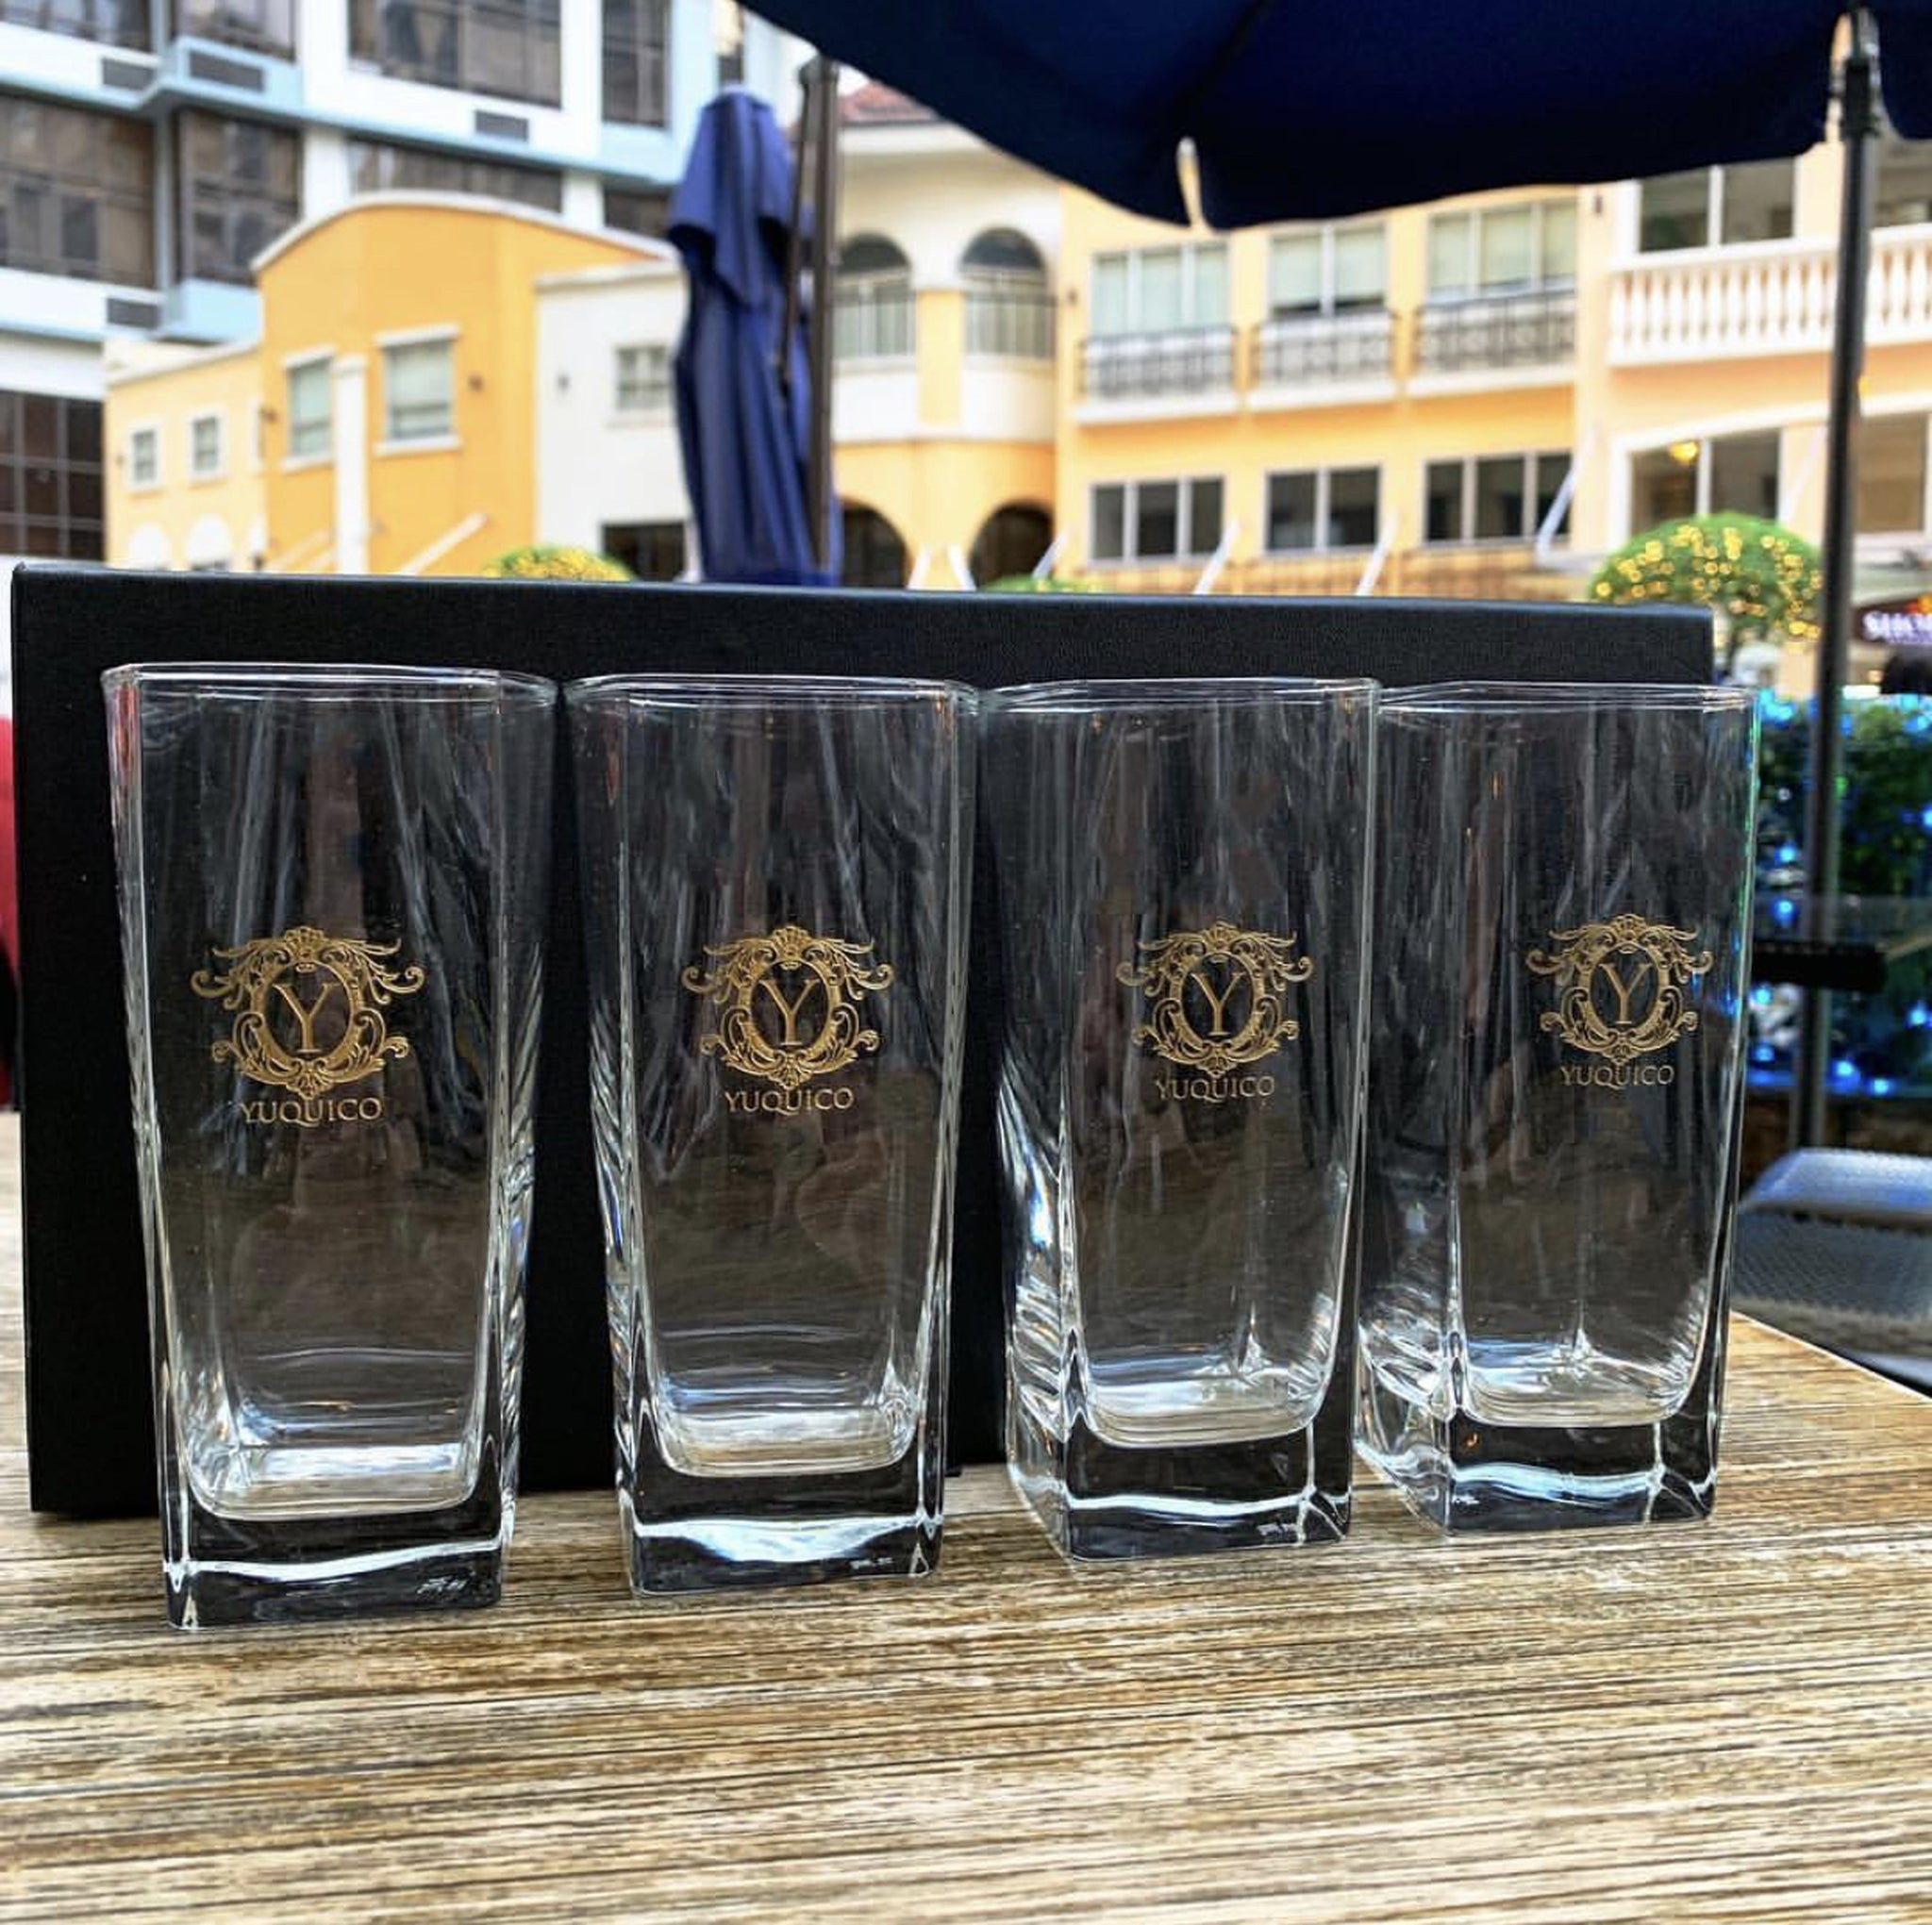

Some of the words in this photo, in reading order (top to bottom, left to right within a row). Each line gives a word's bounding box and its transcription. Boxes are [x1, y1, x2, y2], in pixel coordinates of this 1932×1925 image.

[758, 978, 822, 1046] Y
[1191, 971, 1246, 1036] Y
[1599, 962, 1652, 1024] Y
[272, 982, 341, 1054] Y
[1156, 1075, 1274, 1103] YUQUICO
[1559, 1065, 1674, 1090] YUQUICO
[241, 1097, 381, 1127] YUQUICO
[724, 1087, 854, 1116] YUQUICO
